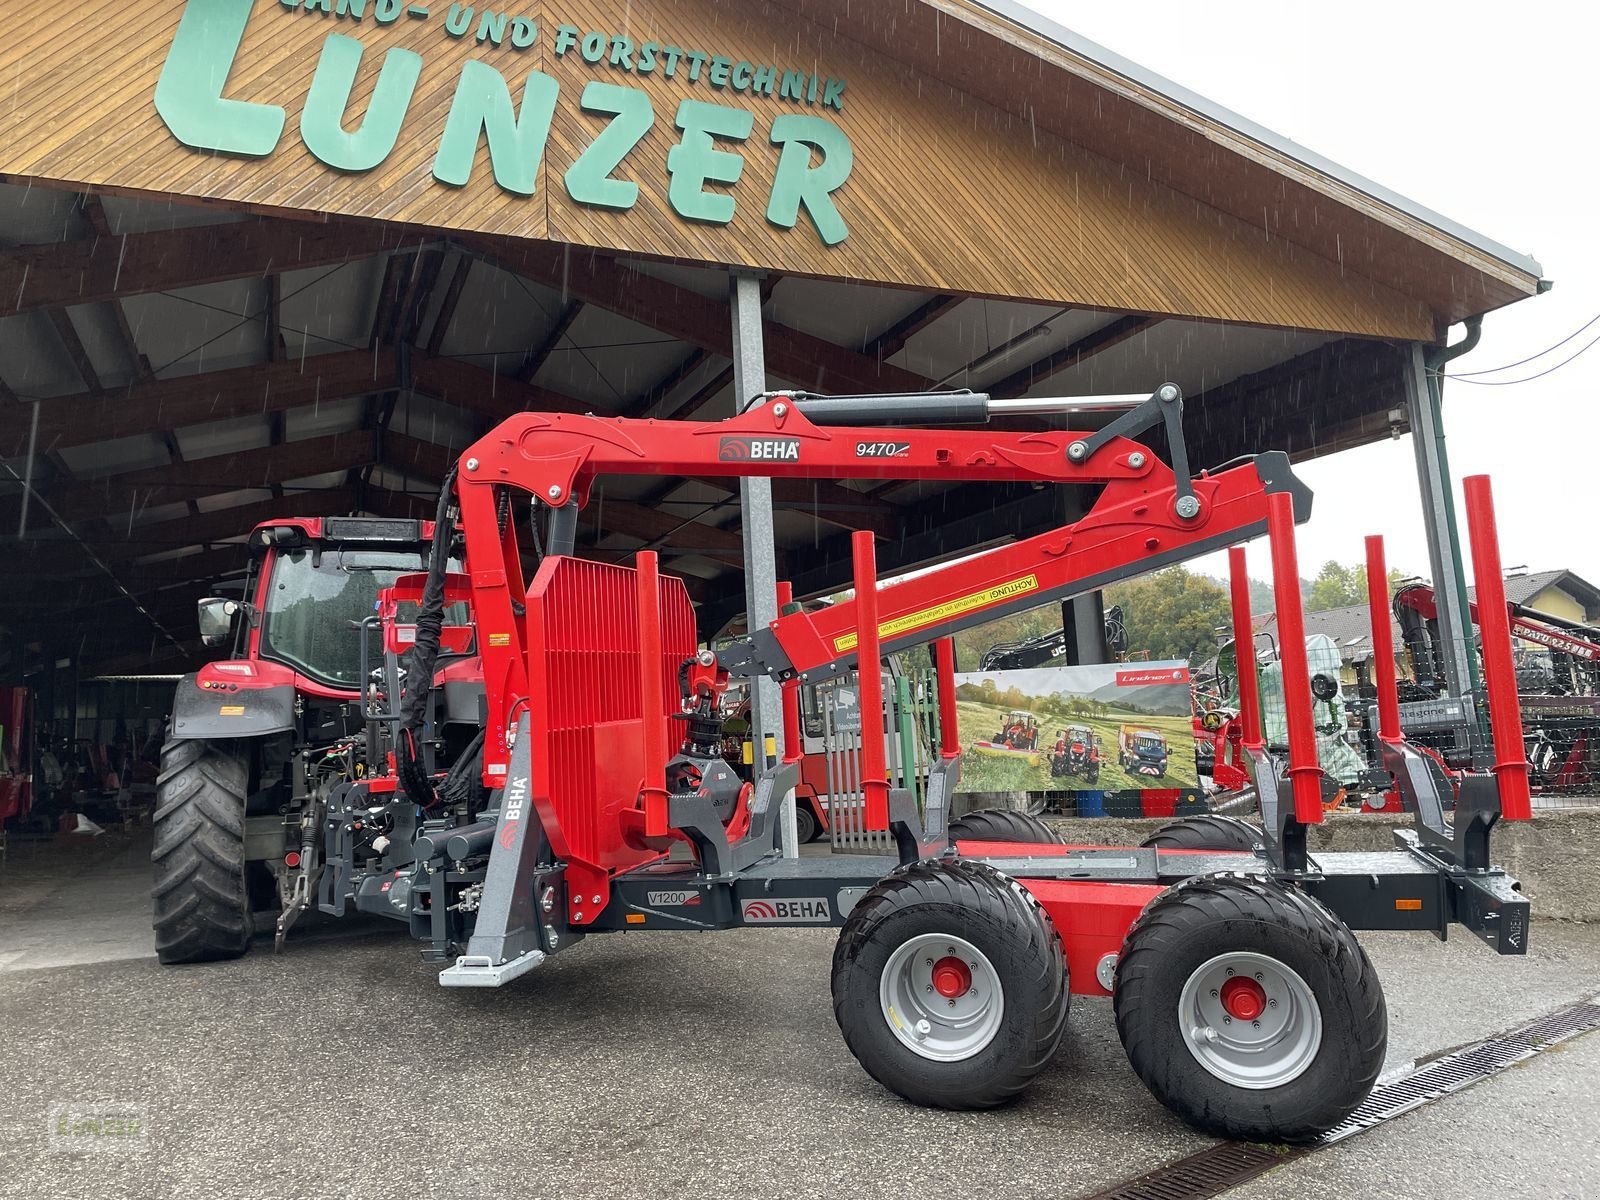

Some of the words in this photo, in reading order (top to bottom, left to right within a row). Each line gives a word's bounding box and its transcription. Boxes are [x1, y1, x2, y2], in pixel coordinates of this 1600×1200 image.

[444, 2, 538, 50] UND
[554, 24, 846, 112] FORSTTECHNIK
[153, 0, 854, 247] LUNZER
[751, 441, 798, 459] BEHA
[856, 443, 896, 456] 9470
[989, 578, 1033, 599] ACHTUNG!
[954, 594, 986, 610] Aufenthalt
[893, 608, 945, 628] Gefahrenbereich
[1050, 644, 1067, 657] JC
[1121, 674, 1168, 683] Lindner
[505, 776, 528, 820] BEHA
[648, 892, 686, 904] V1200
[775, 901, 829, 919] BEHA
